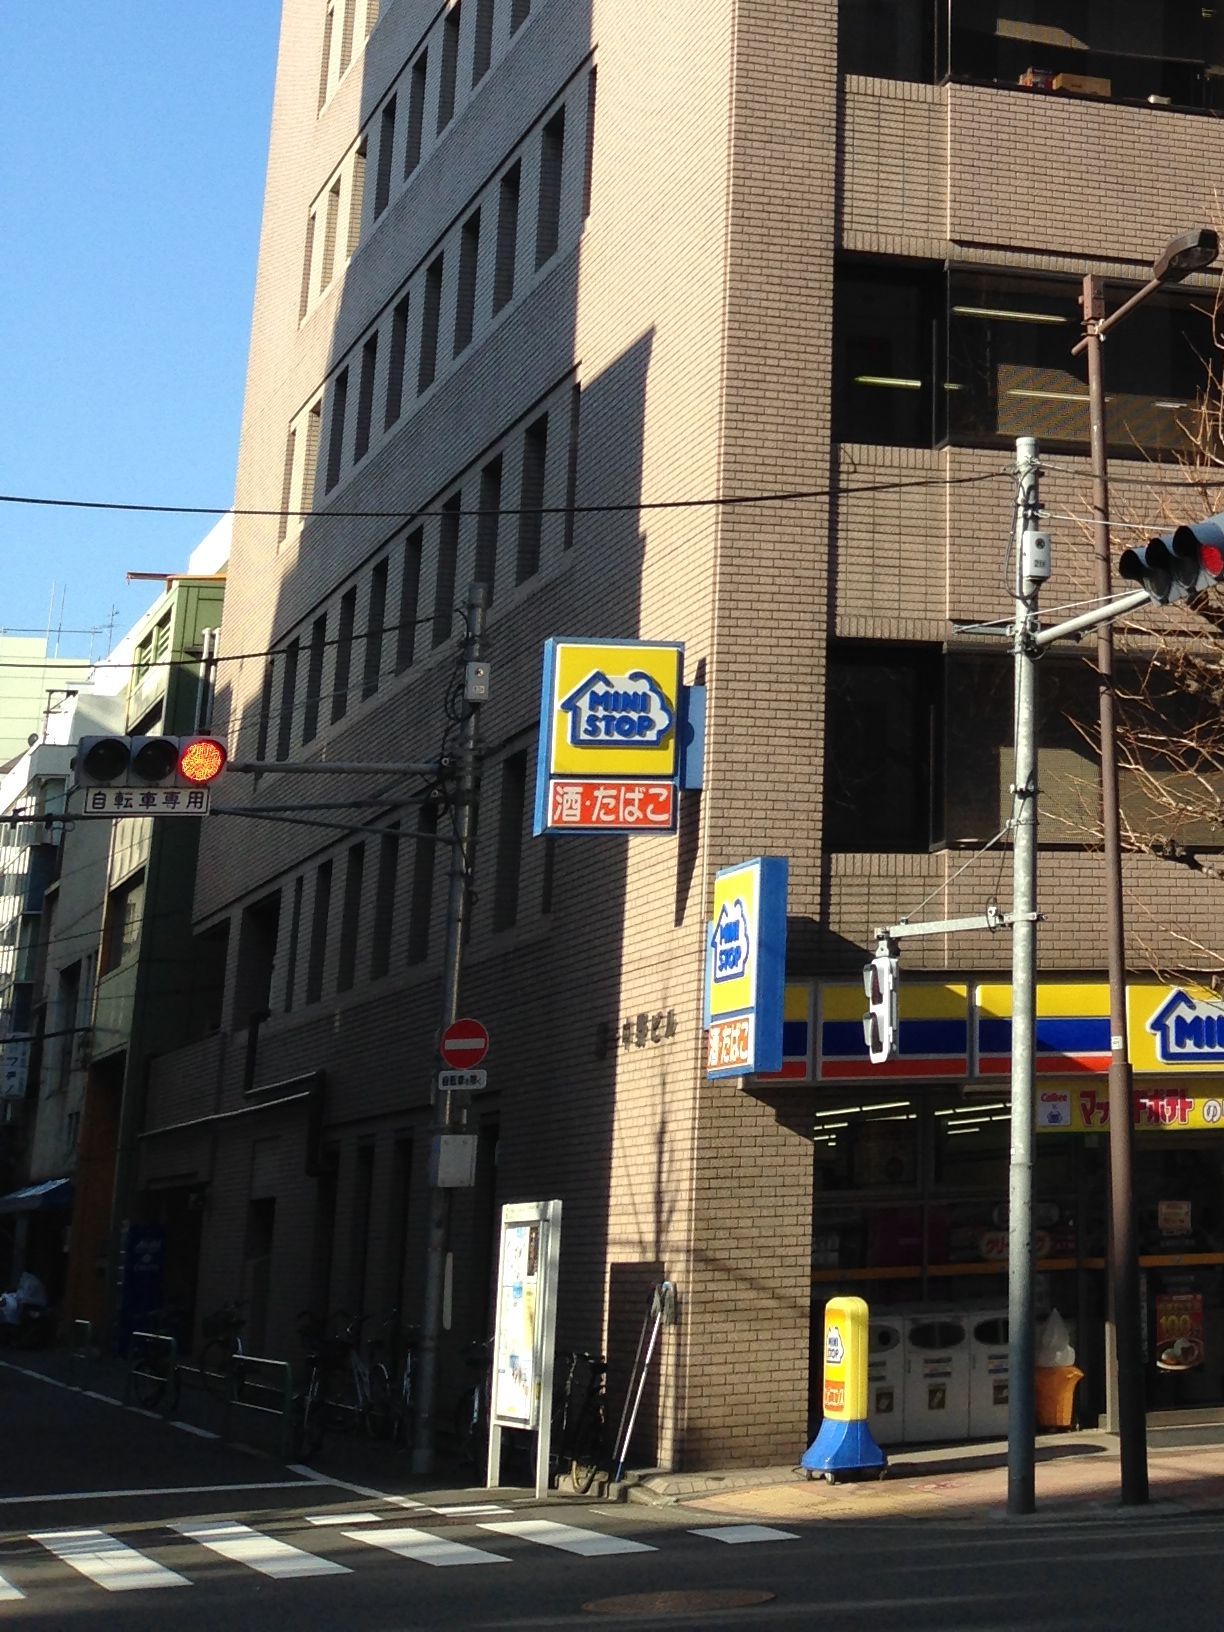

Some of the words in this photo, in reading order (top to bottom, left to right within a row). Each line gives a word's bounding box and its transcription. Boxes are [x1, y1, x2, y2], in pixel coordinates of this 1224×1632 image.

[588, 690, 652, 714] MINI
[583, 714, 657, 739] STOP
[92, 791, 204, 810] 自転車専用
[553, 785, 670, 823] 酒・たばこ
[719, 920, 740, 945] MINI
[718, 945, 742, 972] STOP
